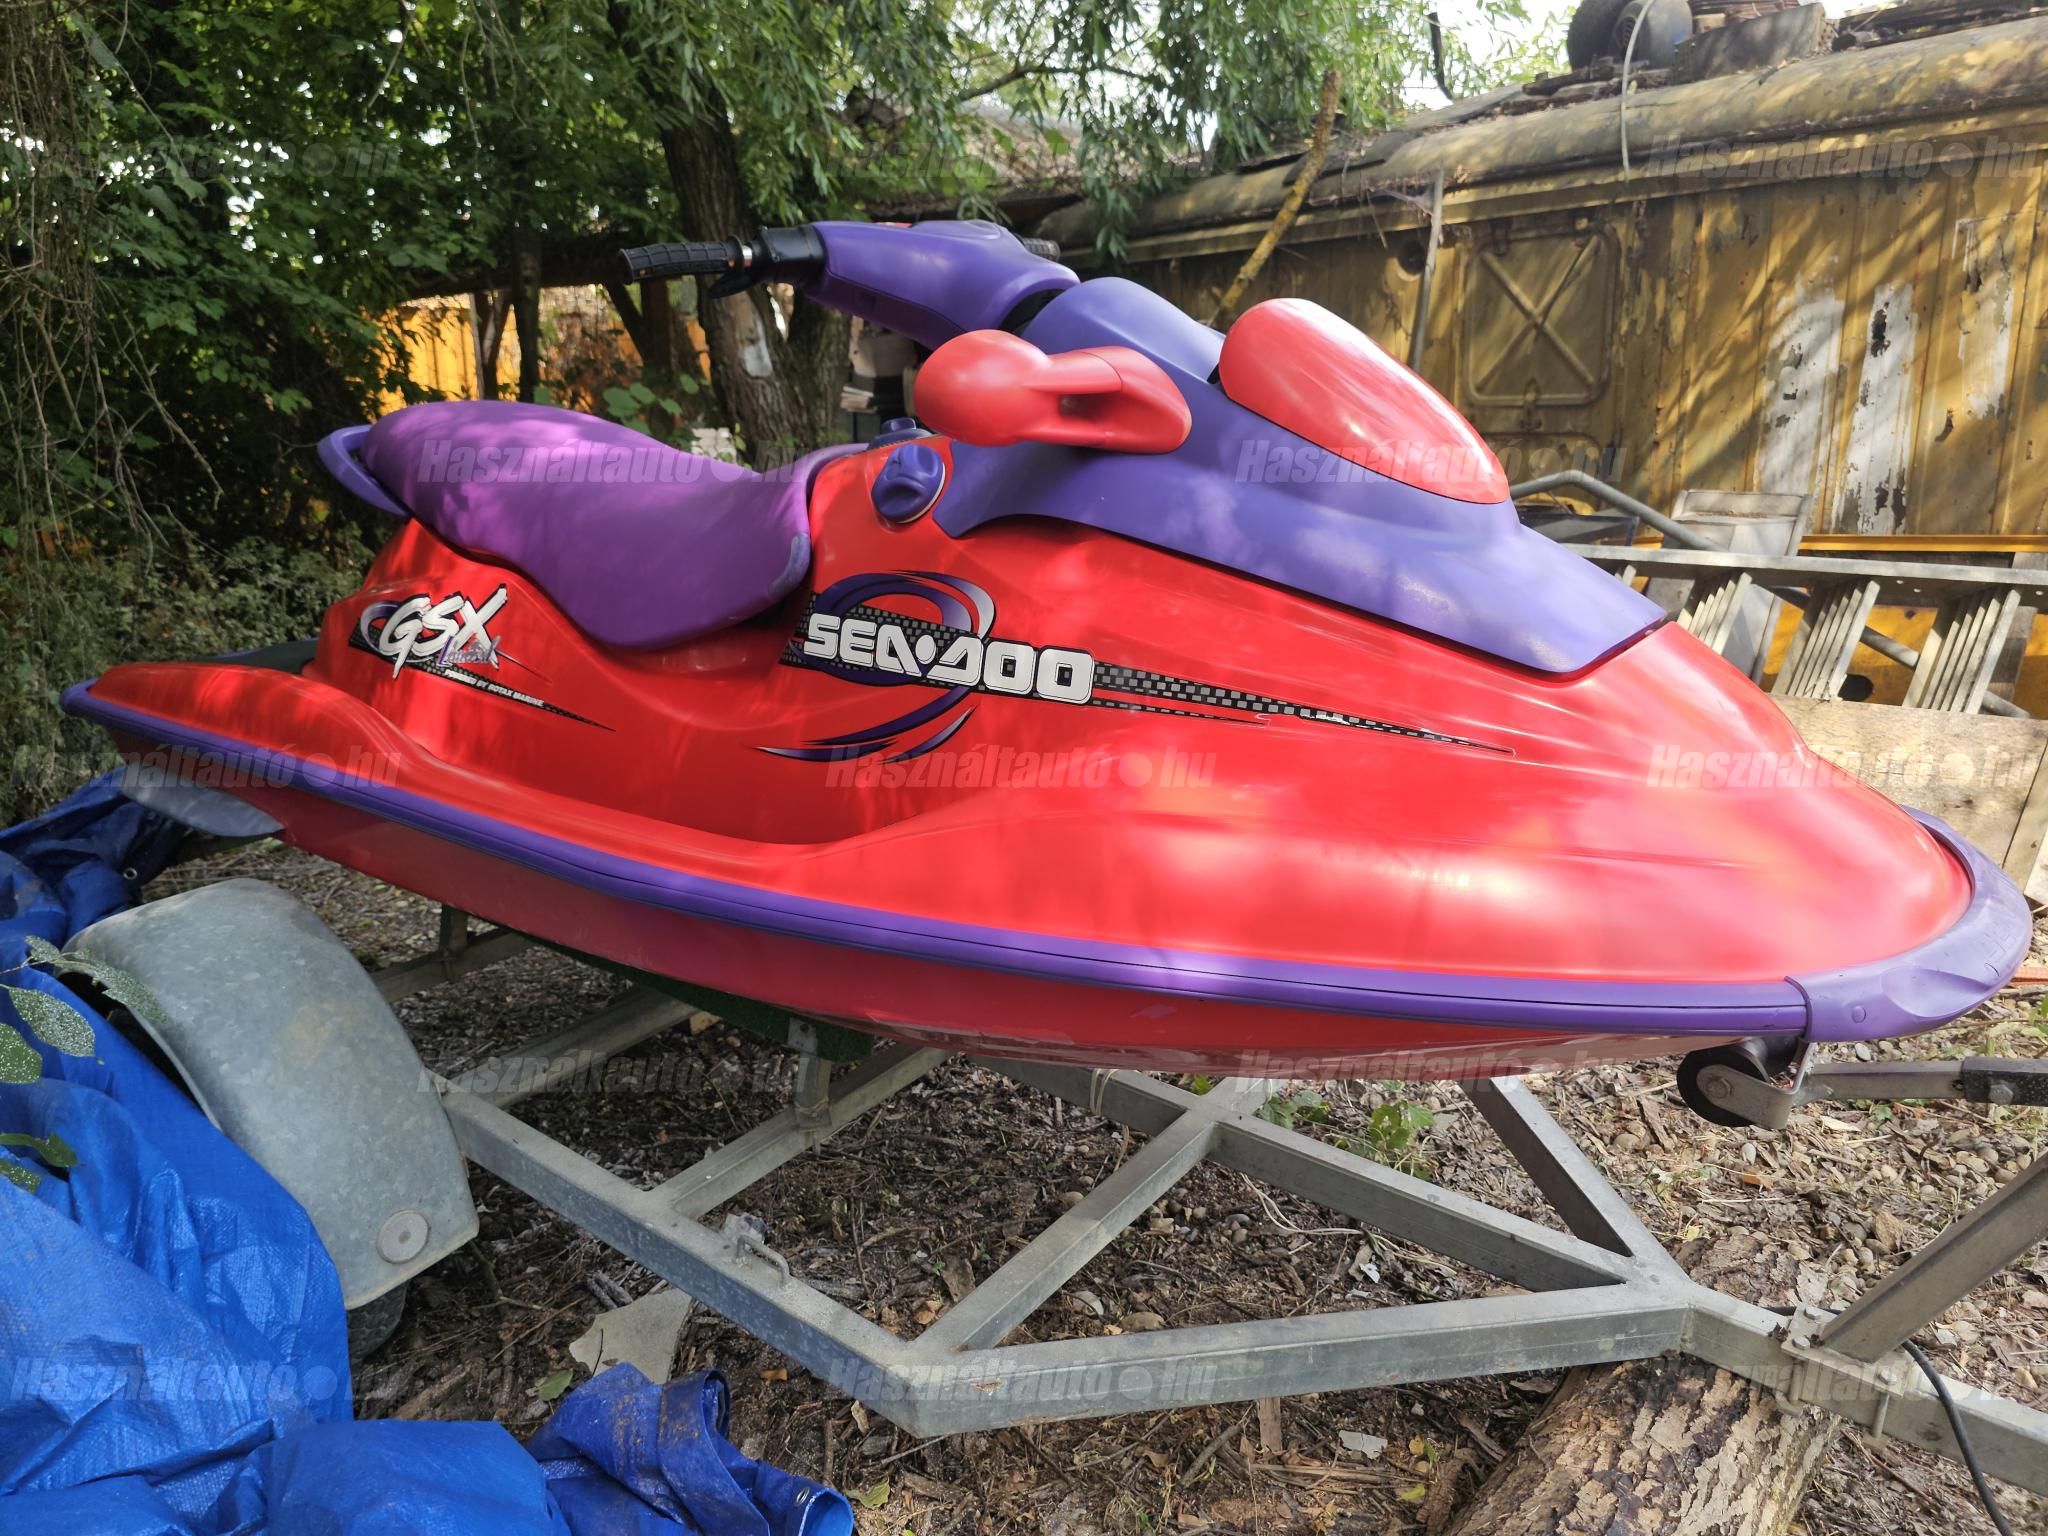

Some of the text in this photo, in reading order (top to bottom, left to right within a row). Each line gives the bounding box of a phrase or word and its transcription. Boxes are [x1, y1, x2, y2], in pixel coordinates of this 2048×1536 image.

[377, 583, 509, 679] GSX
[476, 680, 489, 688] BY
[488, 684, 513, 697] ROTAX
